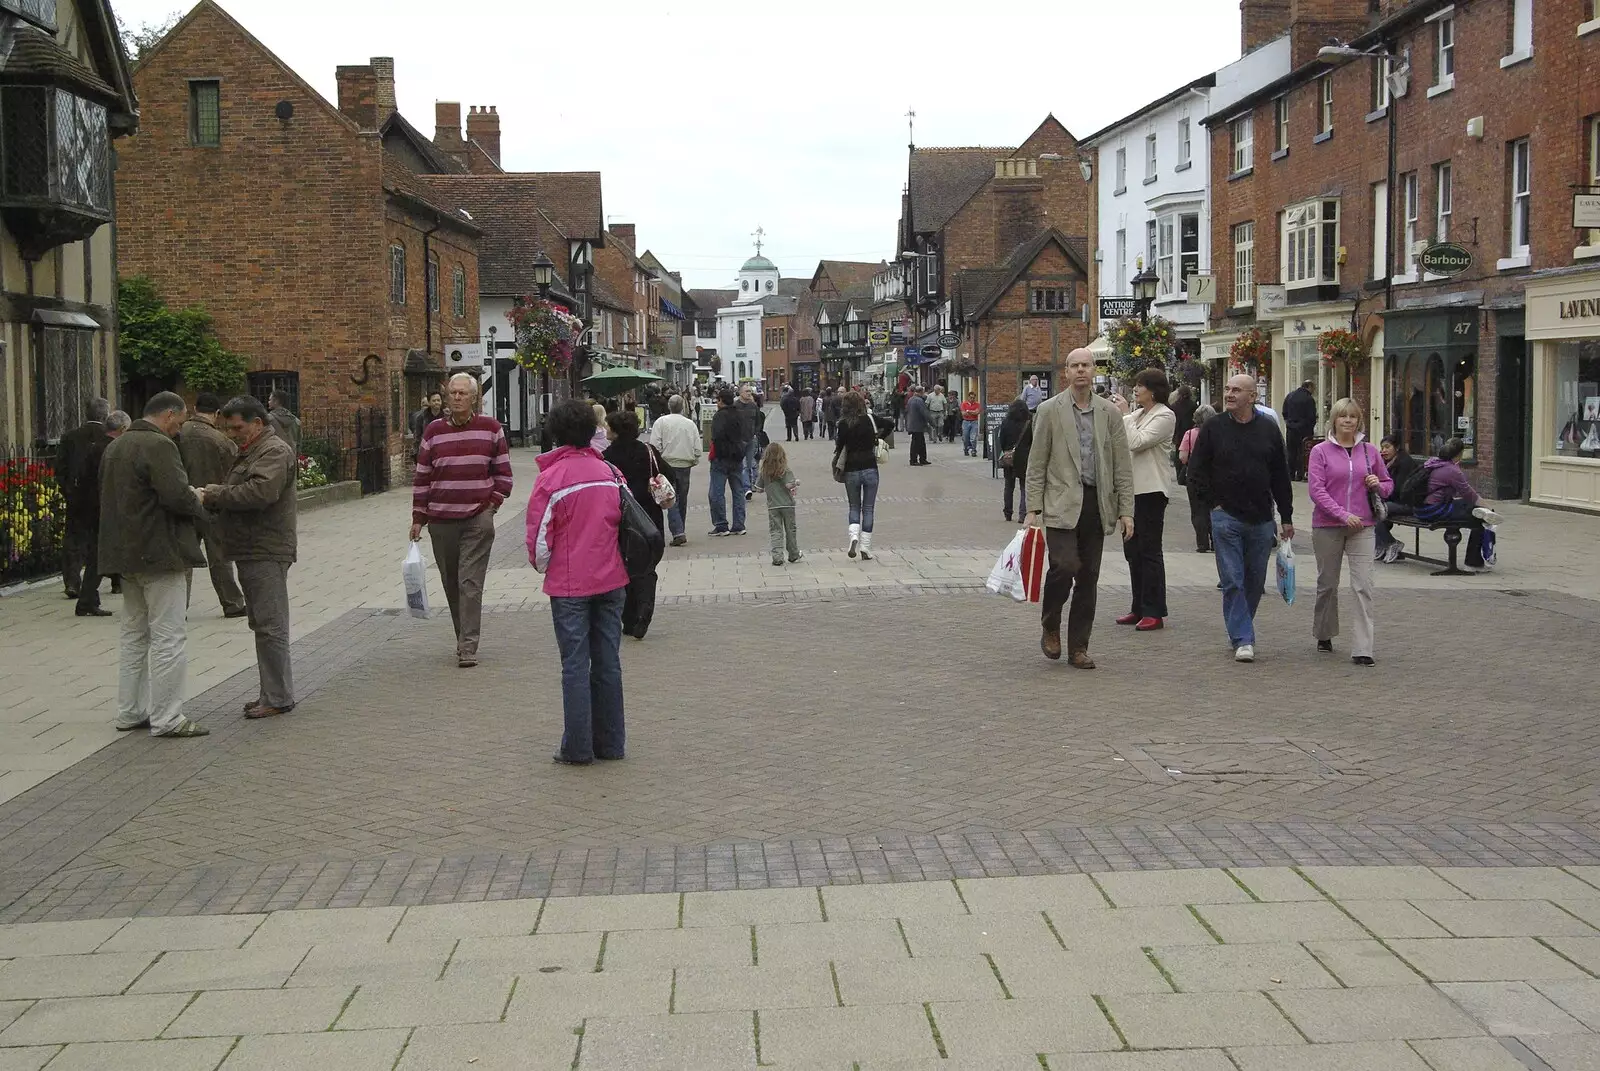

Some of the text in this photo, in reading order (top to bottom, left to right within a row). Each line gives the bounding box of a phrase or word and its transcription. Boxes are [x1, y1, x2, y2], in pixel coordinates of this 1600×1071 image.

[1423, 254, 1470, 265] Barbour
[1196, 278, 1210, 296] V
[1103, 301, 1136, 309] ANTIQUE
[1104, 308, 1134, 316] CENTRE
[1453, 322, 1472, 335] 47
